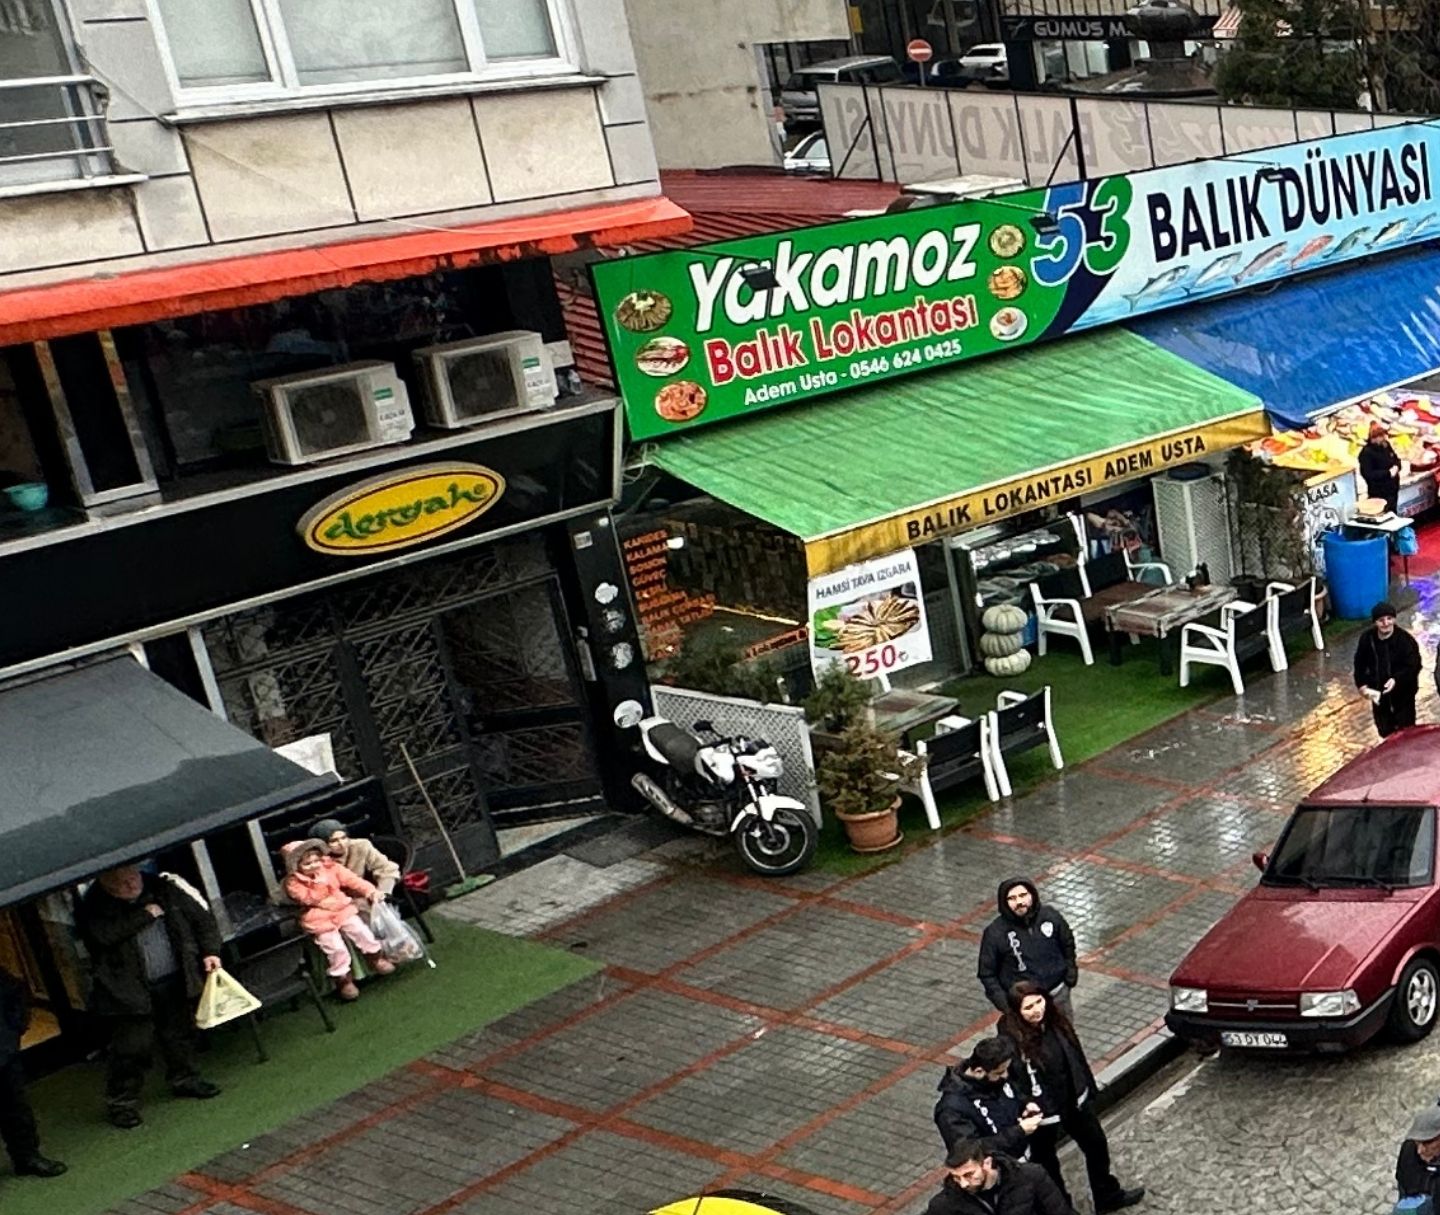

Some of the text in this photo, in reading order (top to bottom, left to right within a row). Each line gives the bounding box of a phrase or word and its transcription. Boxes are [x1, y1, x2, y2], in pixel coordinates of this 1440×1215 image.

[1031, 141, 1432, 286] 53 BALIK DÜNYASI
[689, 223, 981, 332] Yakamoz
[704, 294, 979, 386] Balık Lokantası
[744, 375, 798, 405] Adem
[800, 369, 838, 392] Usta
[850, 354, 890, 379] 0546
[892, 347, 922, 370] 624
[926, 338, 962, 361] 0425
[906, 434, 1206, 542] BALIK LOKANTASI ADEM USTA
[1307, 482, 1339, 504] KASA
[815, 578, 851, 600] HAMSİ
